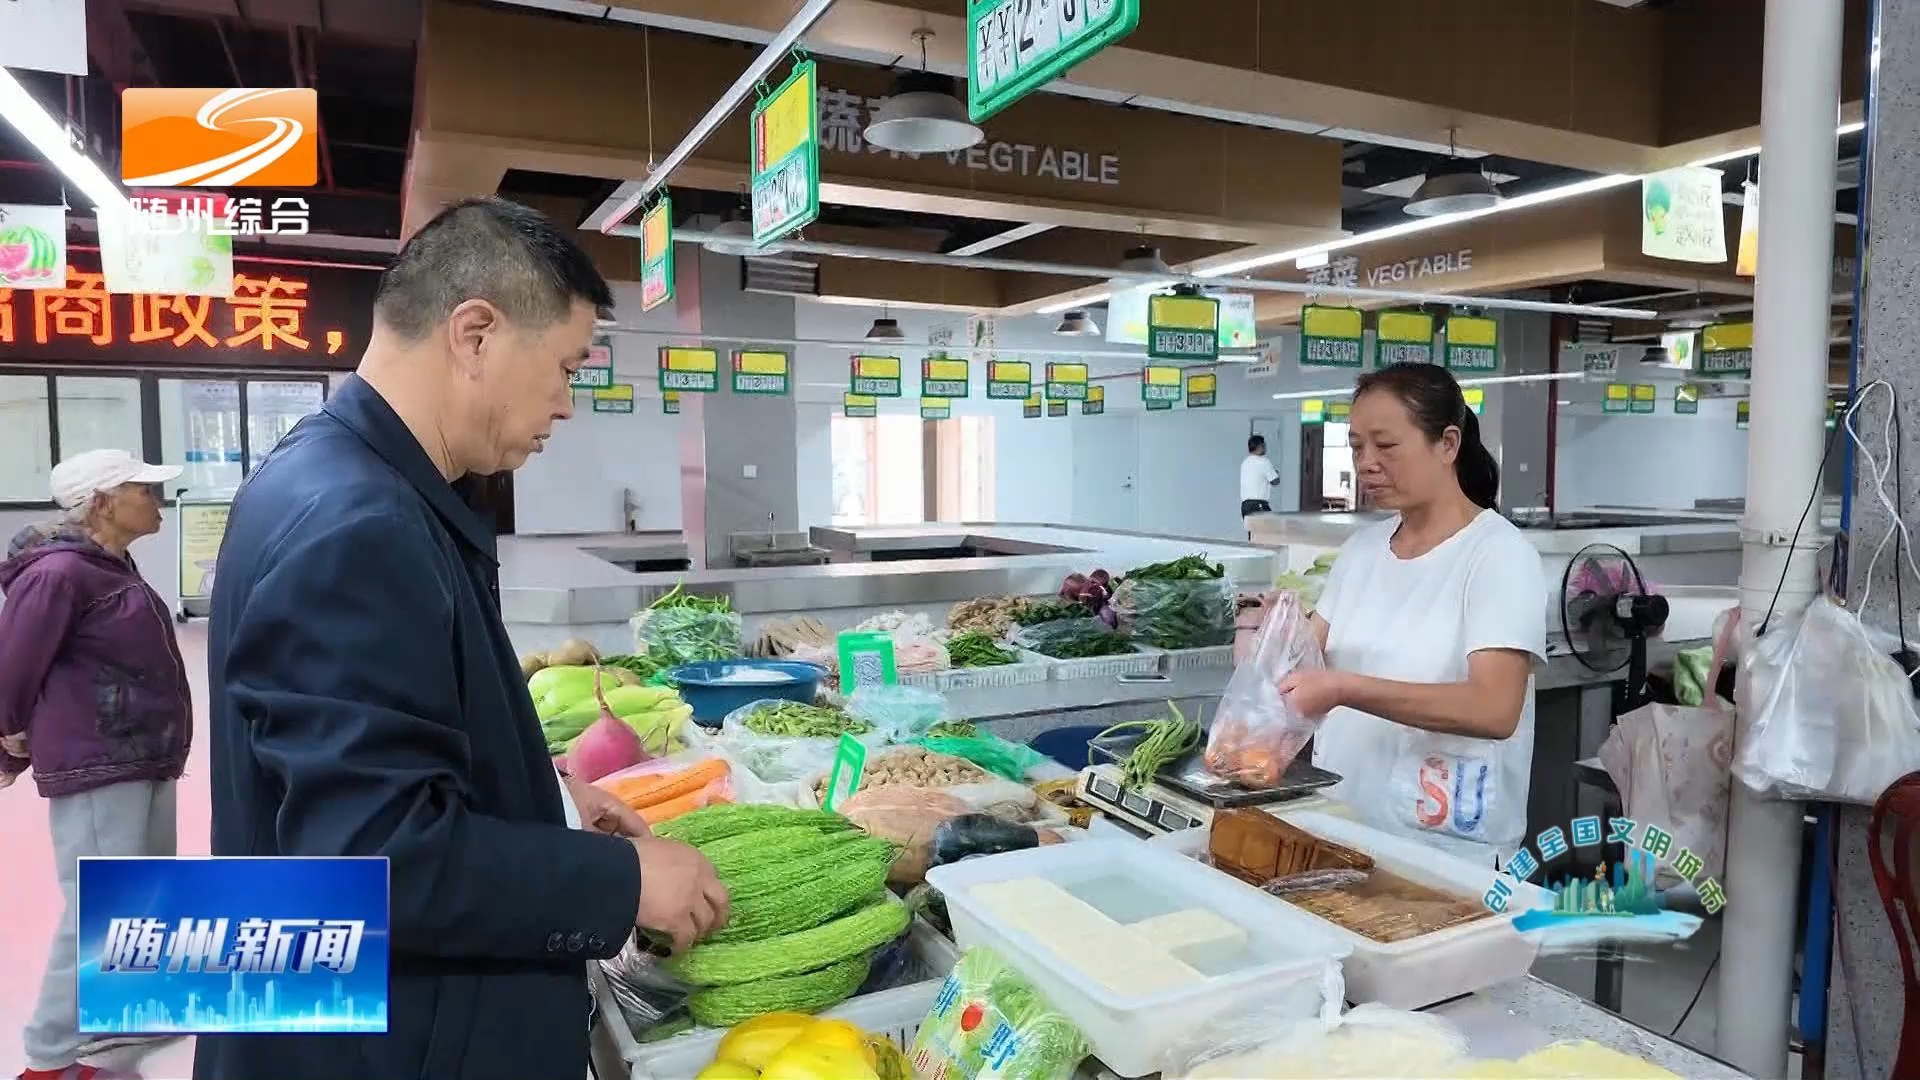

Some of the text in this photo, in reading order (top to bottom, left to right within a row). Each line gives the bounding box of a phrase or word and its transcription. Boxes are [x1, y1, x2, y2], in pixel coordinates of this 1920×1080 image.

[1367, 249, 1473, 288] VEGTABLE
[0, 264, 343, 355] 商政策，
